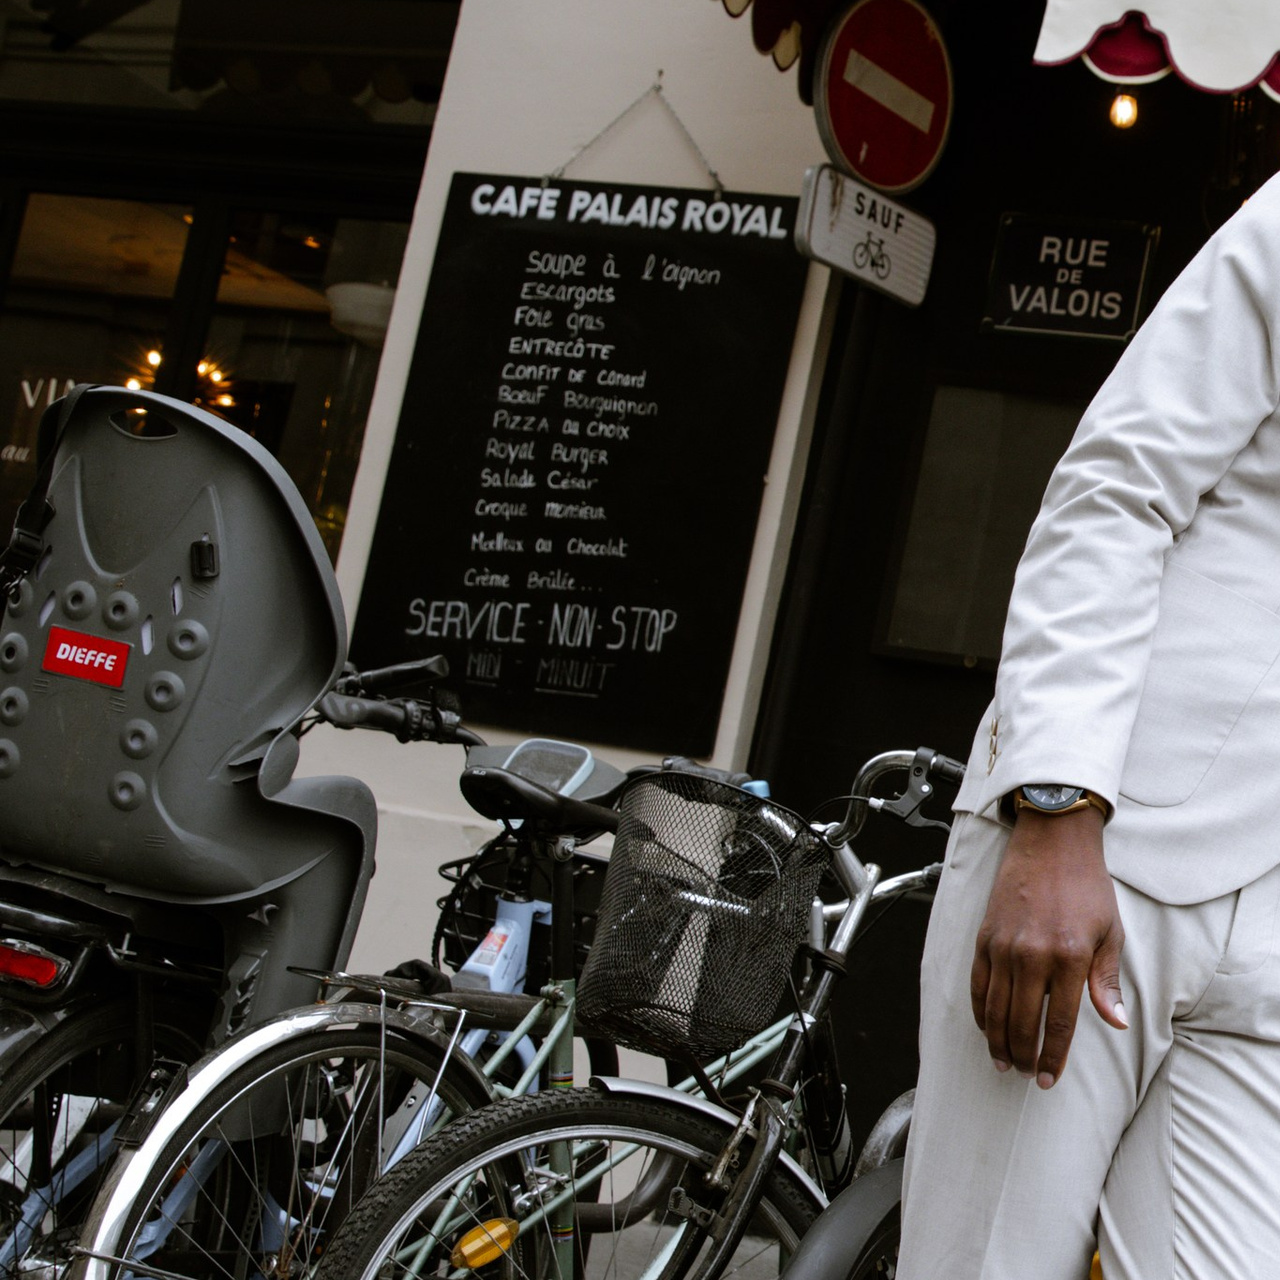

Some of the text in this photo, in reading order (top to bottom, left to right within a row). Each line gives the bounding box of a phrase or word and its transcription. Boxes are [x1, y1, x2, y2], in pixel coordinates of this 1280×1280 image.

[470, 183, 789, 239] CAFE PALAIS ROYAL
[854, 191, 906, 235] SAUF
[1039, 236, 1110, 268] RUE
[1056, 268, 1084, 285] DE
[520, 282, 616, 310] Escargots
[1009, 284, 1124, 320] VALOIS
[566, 311, 605, 338] gras
[508, 336, 616, 361] ENTRECÔTE
[480, 469, 599, 490] Salade César
[463, 568, 510, 588] Crème
[405, 598, 532, 643] SERVICE
[56, 642, 118, 672] DIEFFE
